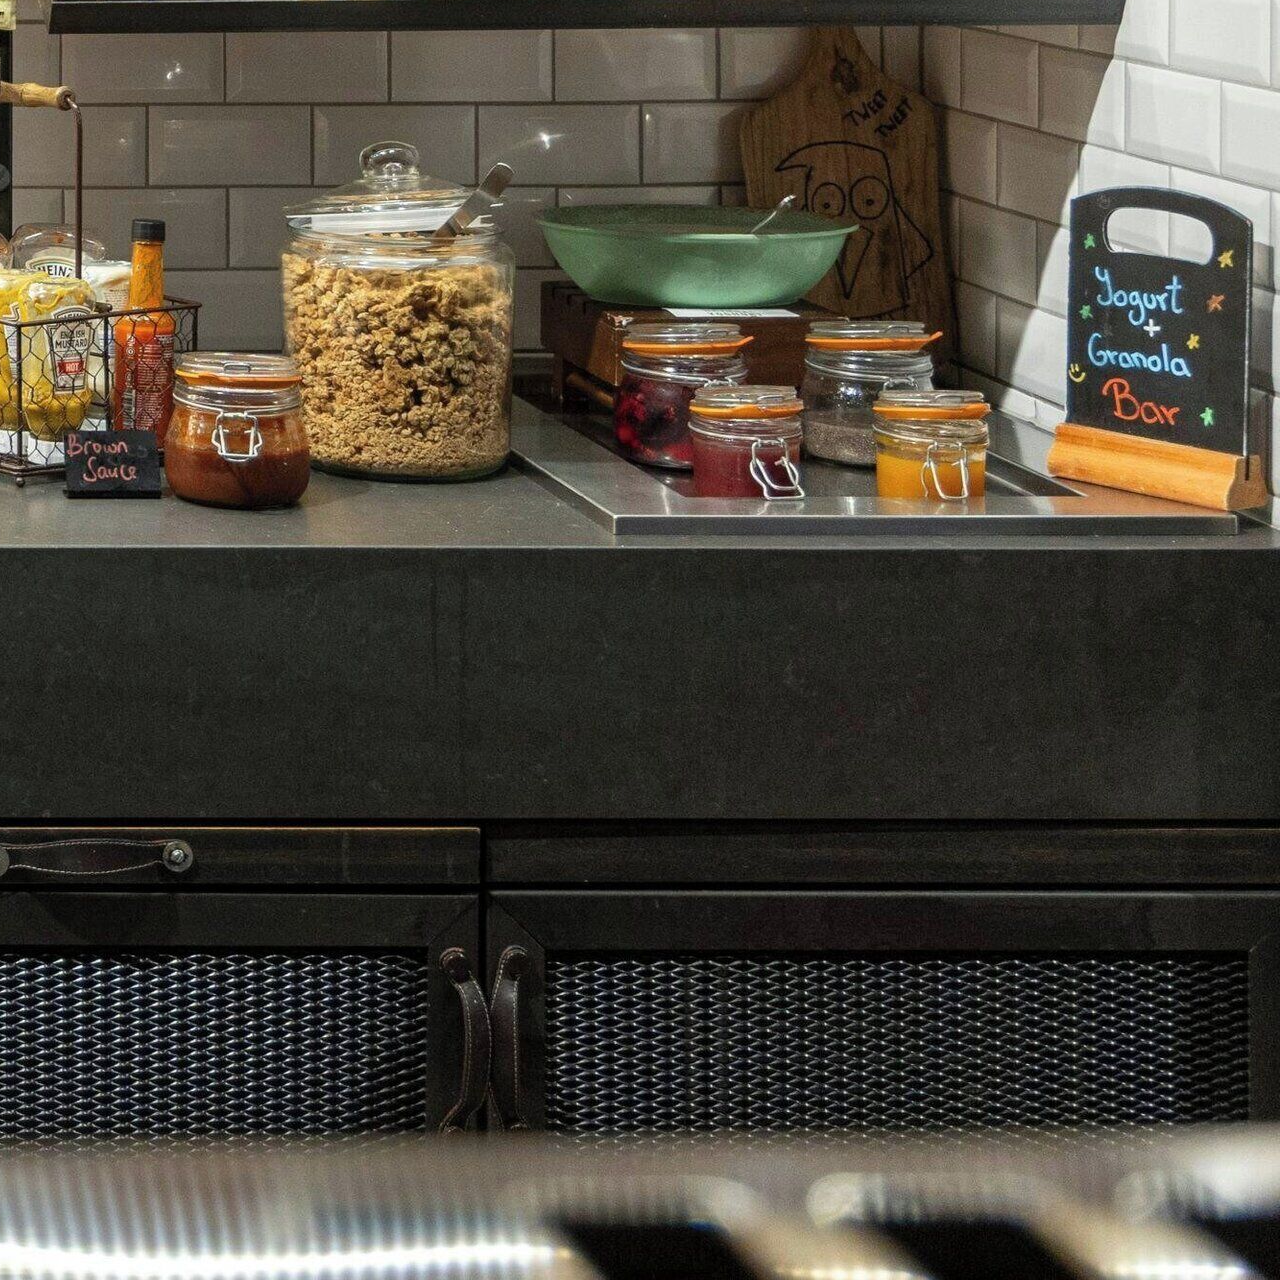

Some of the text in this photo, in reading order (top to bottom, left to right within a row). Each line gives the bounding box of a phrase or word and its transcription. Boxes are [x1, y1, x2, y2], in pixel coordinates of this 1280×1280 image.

[842, 89, 888, 127] TWEET
[874, 97, 913, 138] TWEET
[1094, 266, 1184, 327] Yogurt
[65, 362, 80, 372] HOT
[1088, 333, 1193, 378] Granola
[1101, 377, 1181, 426] Bar
[66, 433, 128, 458] Brown
[82, 456, 137, 483] Sauce
